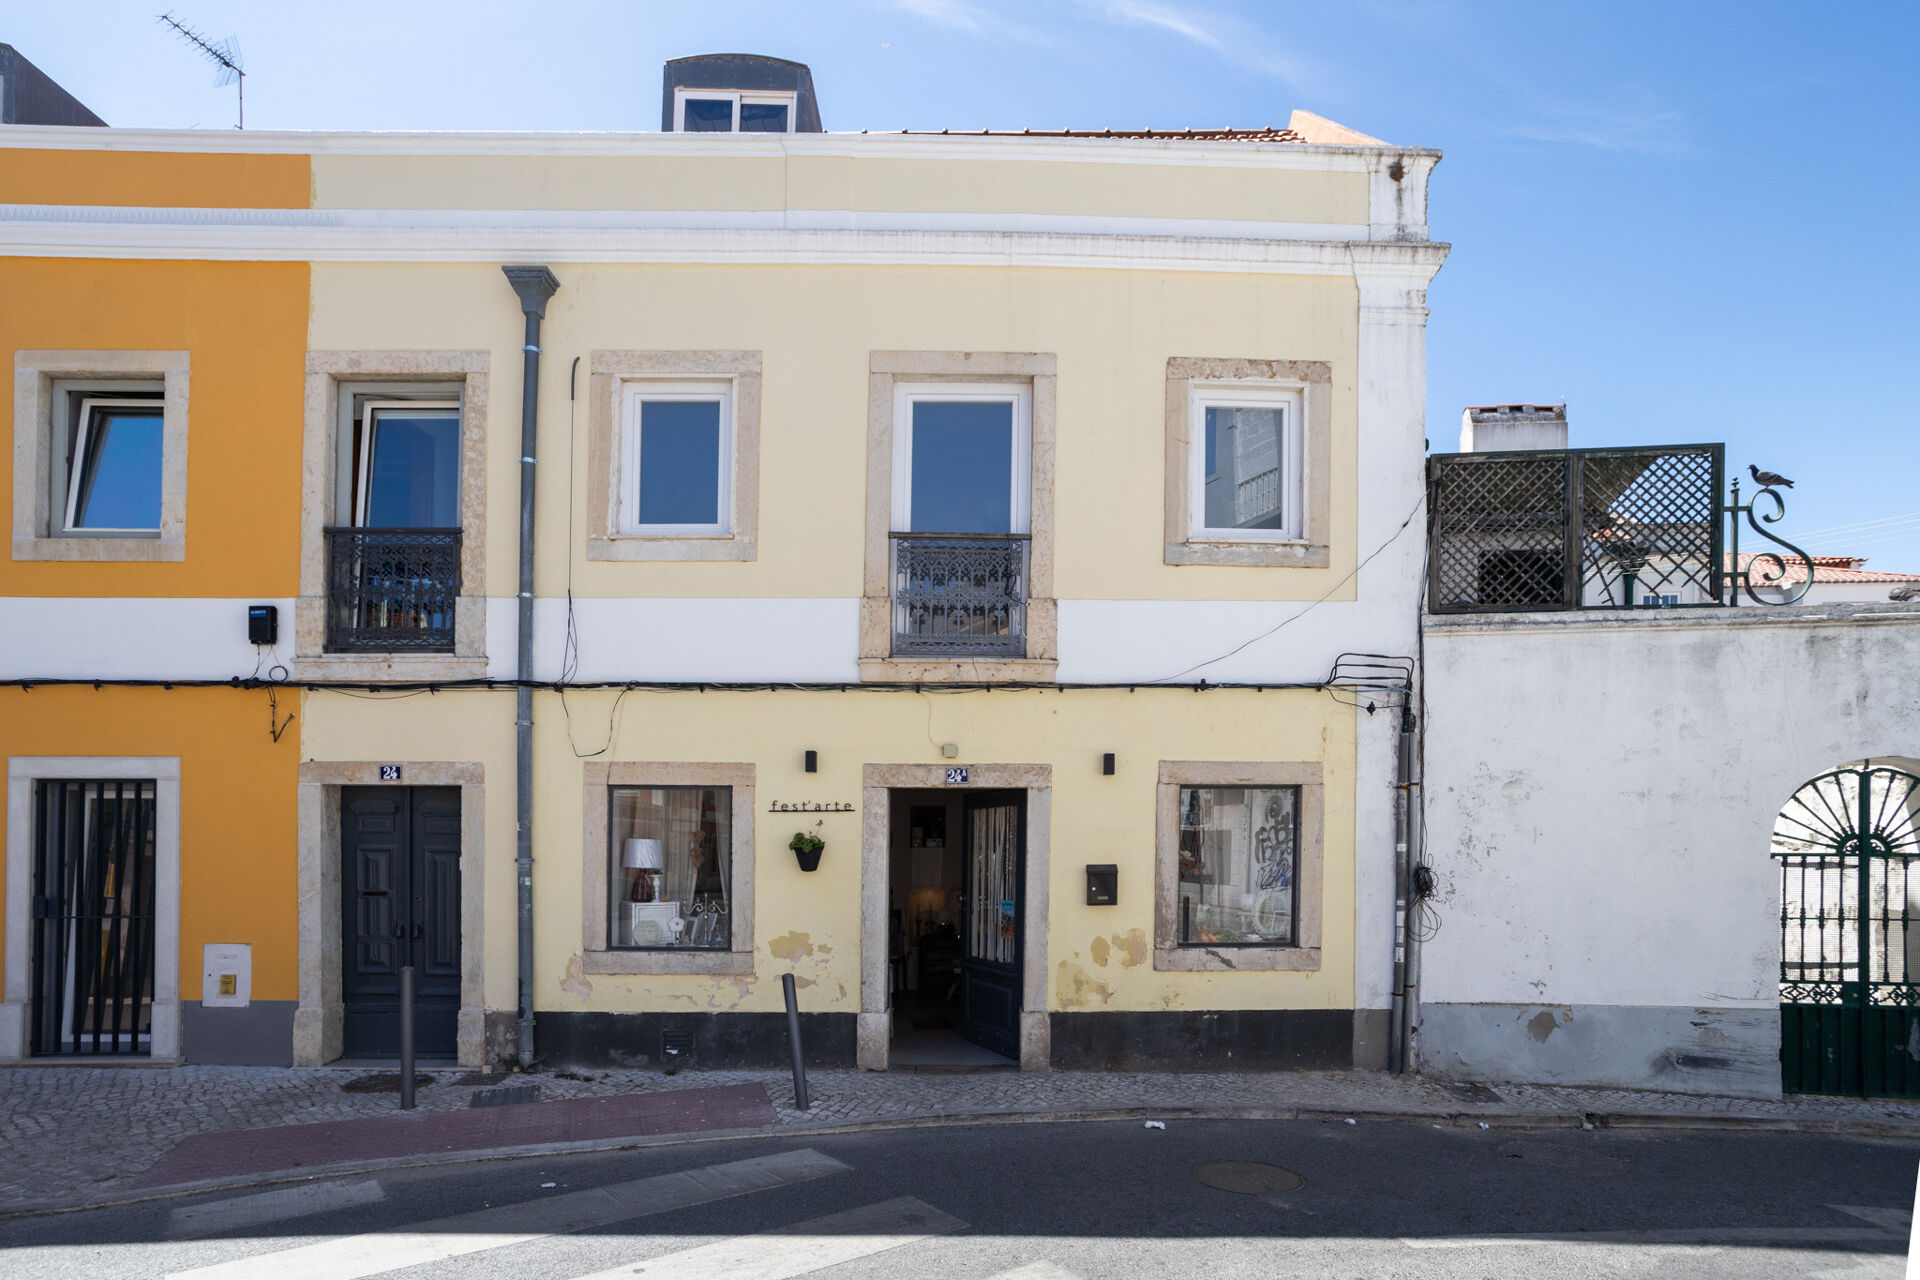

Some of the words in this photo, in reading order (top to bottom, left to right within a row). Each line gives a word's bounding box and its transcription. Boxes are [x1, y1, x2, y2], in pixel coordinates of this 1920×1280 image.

[383, 766, 398, 780] 24
[948, 768, 967, 782] 24A
[771, 800, 852, 812] fest'arte
